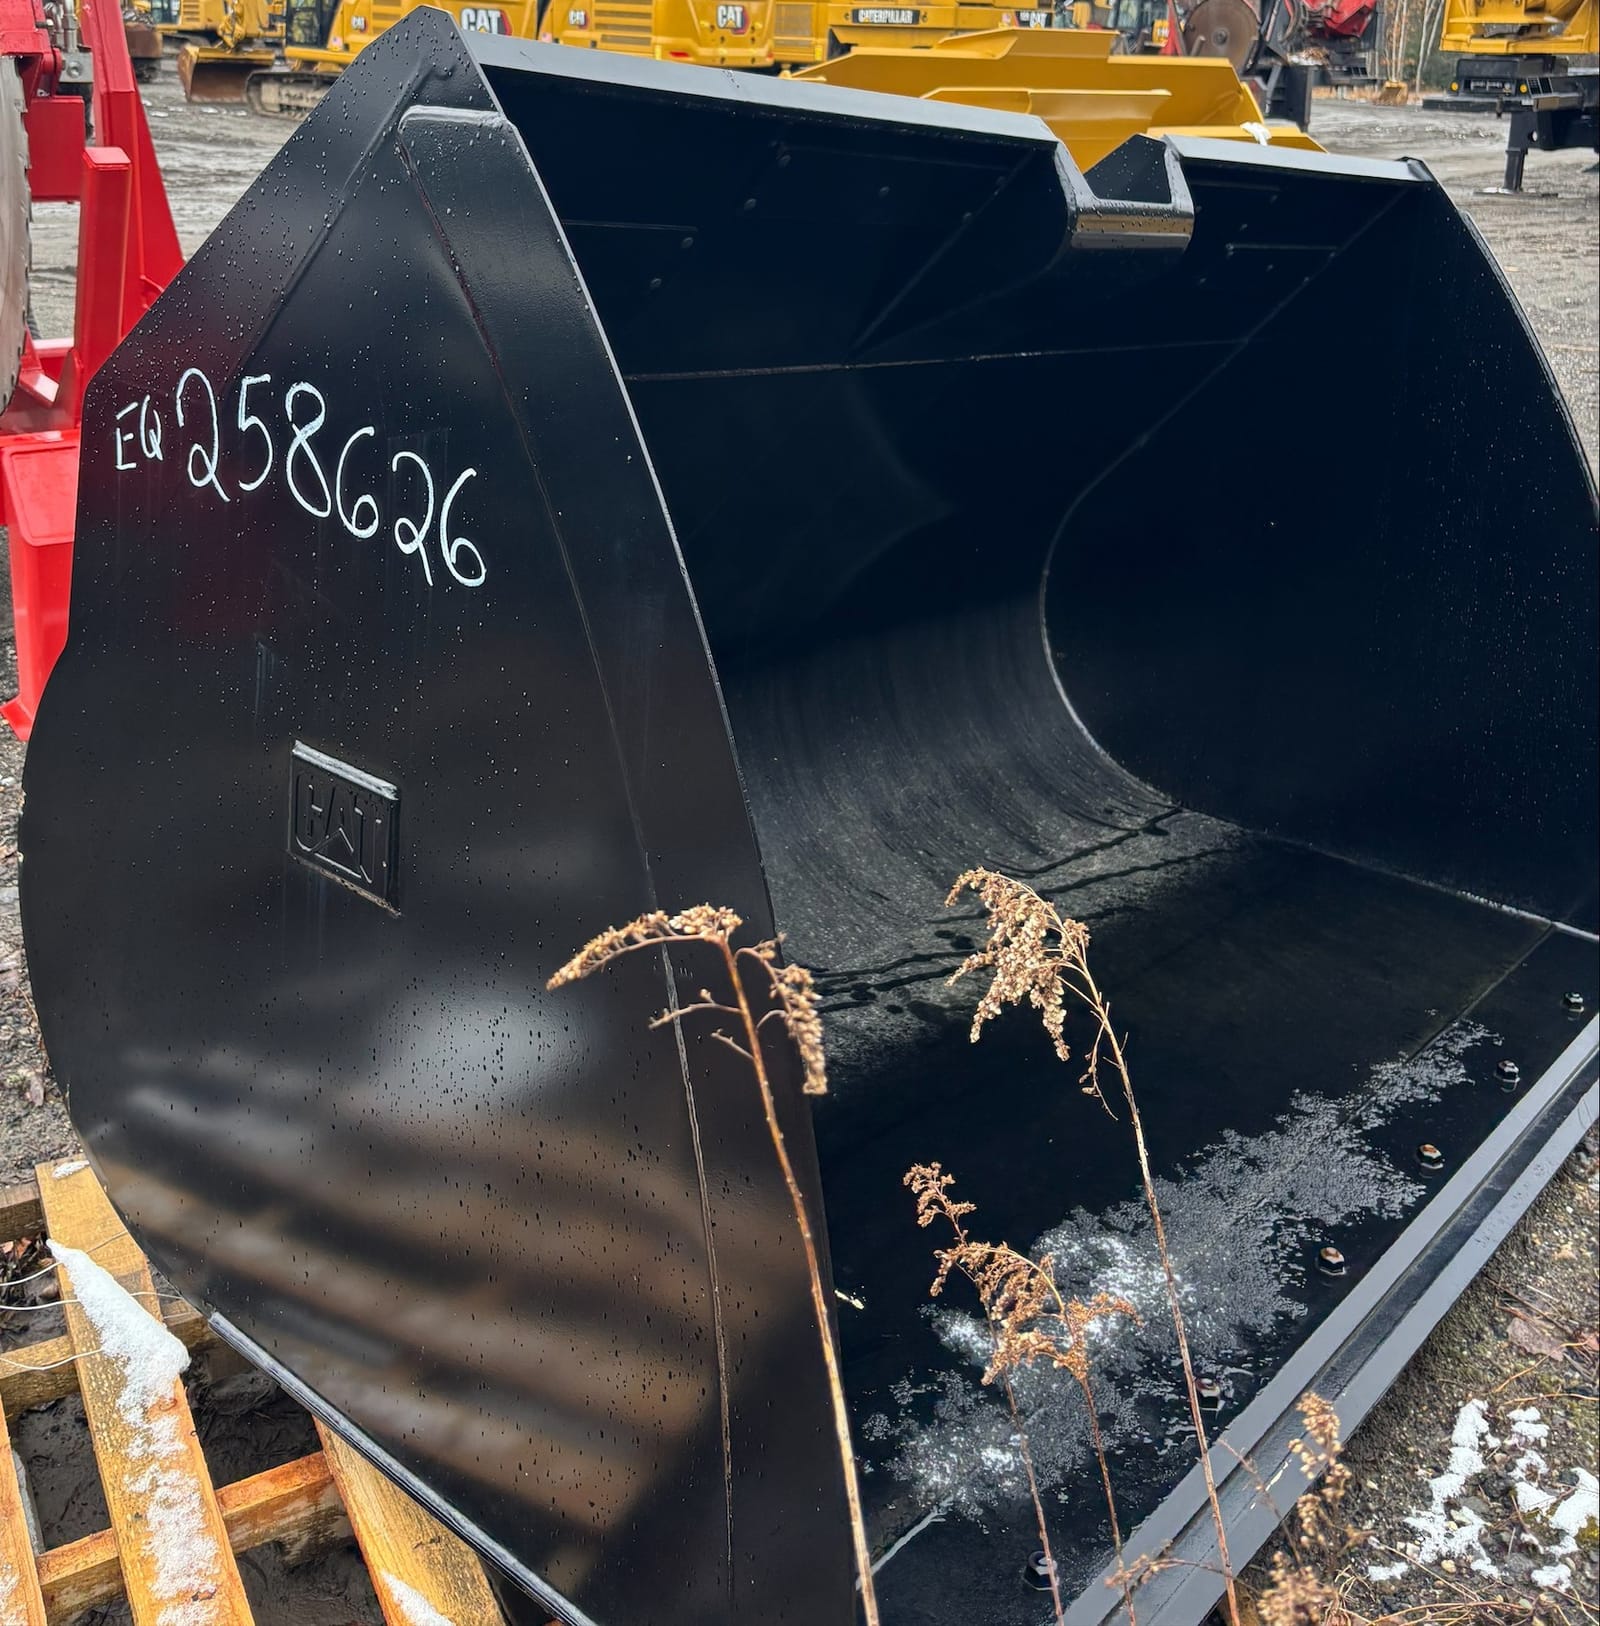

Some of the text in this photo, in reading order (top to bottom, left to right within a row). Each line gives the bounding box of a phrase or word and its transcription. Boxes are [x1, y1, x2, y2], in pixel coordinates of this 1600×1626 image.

[461, 8, 501, 34] CAT
[717, 5, 743, 28] CAT
[858, 8, 913, 24] CATERPILLAR
[115, 367, 487, 588] EQ 258626
[295, 771, 384, 884] CAT
